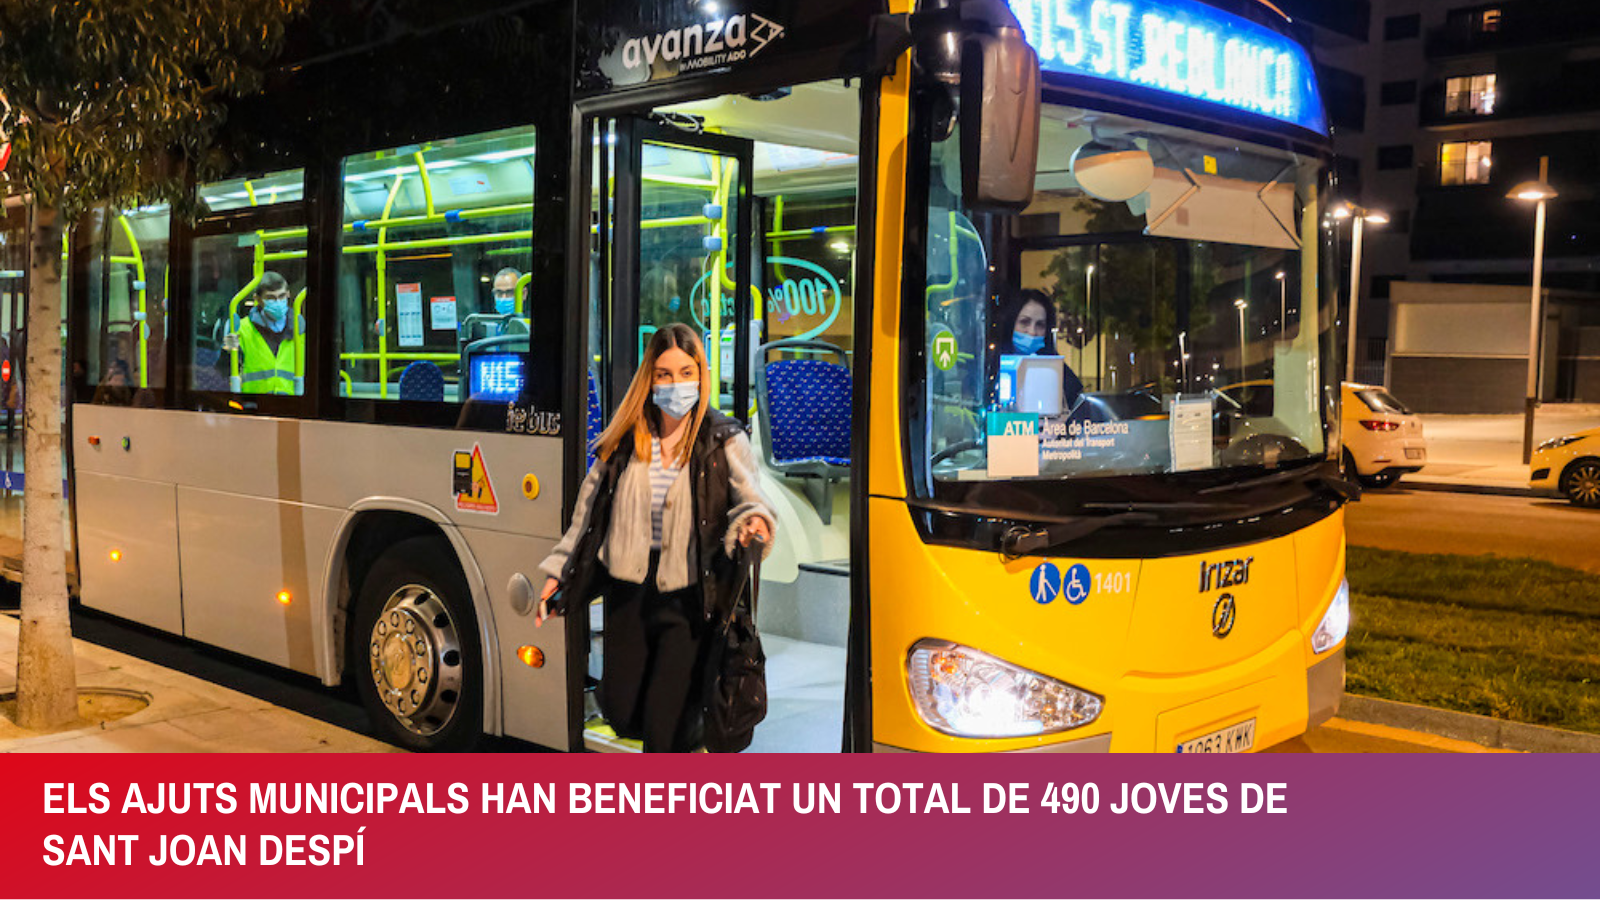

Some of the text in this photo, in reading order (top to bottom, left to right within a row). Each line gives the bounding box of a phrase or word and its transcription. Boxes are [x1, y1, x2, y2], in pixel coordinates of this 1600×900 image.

[622, 13, 747, 70] avanza
[688, 53, 727, 70] MOBILITY
[727, 51, 747, 63] ADO
[1004, 416, 1129, 436] ATM Àrea de Barcelona
[1085, 437, 1115, 449] Transport
[1094, 572, 1131, 594] 1401
